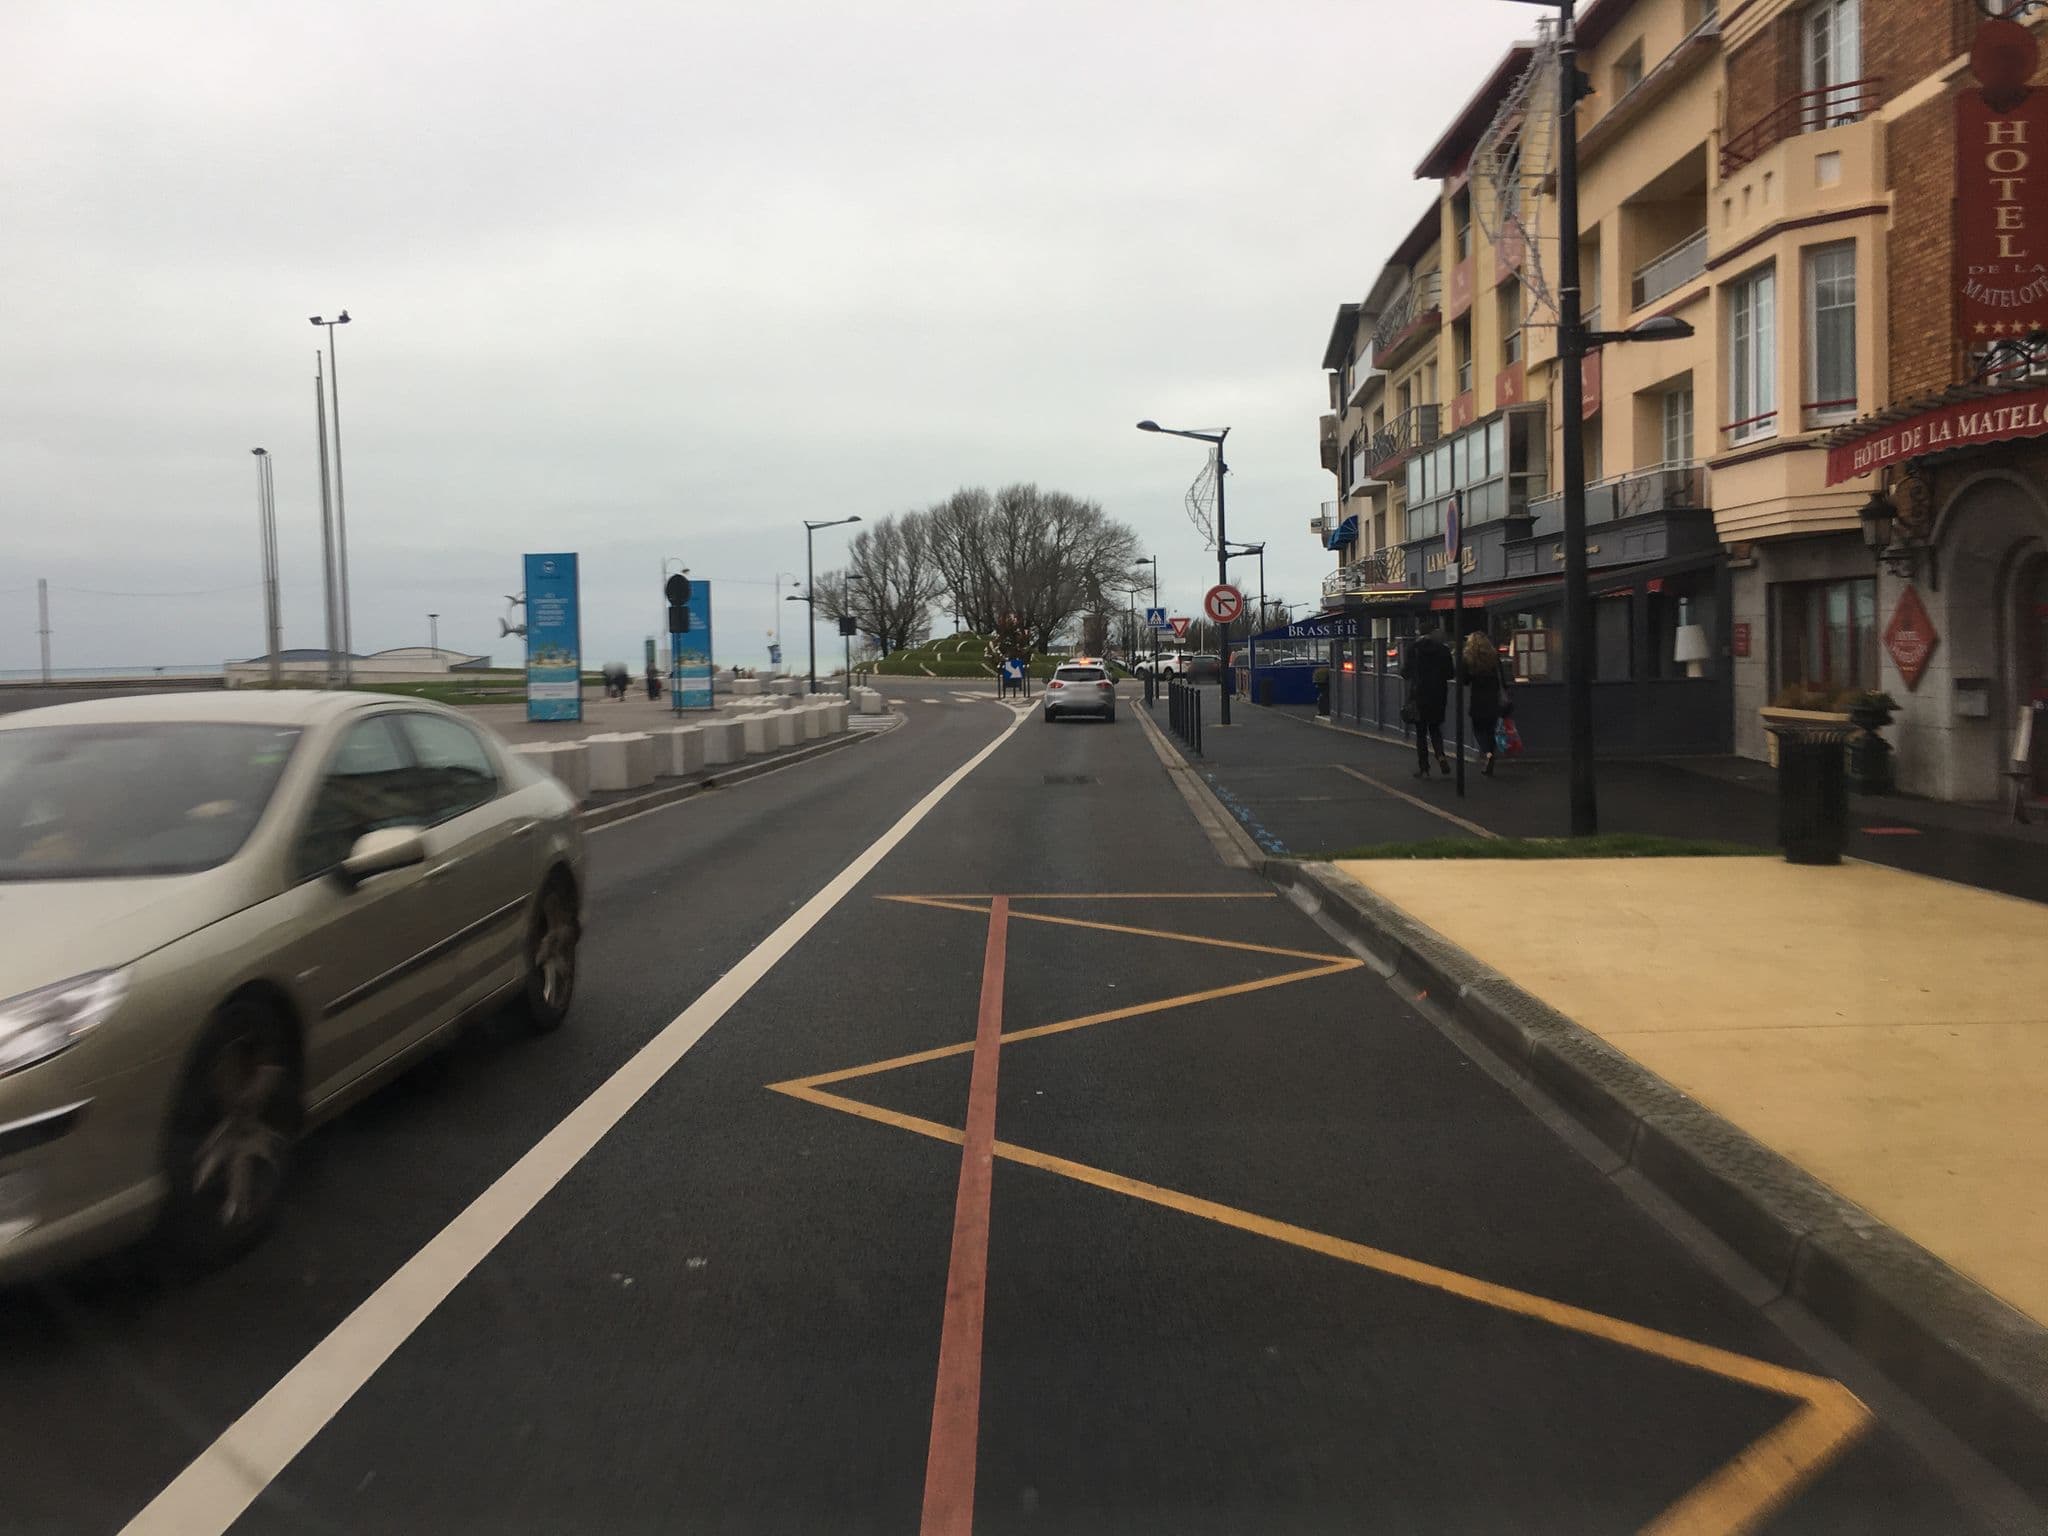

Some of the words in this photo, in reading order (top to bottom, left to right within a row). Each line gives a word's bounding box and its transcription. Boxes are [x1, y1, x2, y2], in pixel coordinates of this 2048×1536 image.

[1983, 120, 2029, 258] HOTEL
[1968, 264, 2000, 275] DE
[2014, 263, 2047, 274] LA
[1901, 426, 1922, 453] DE
[1927, 420, 1952, 444] LA
